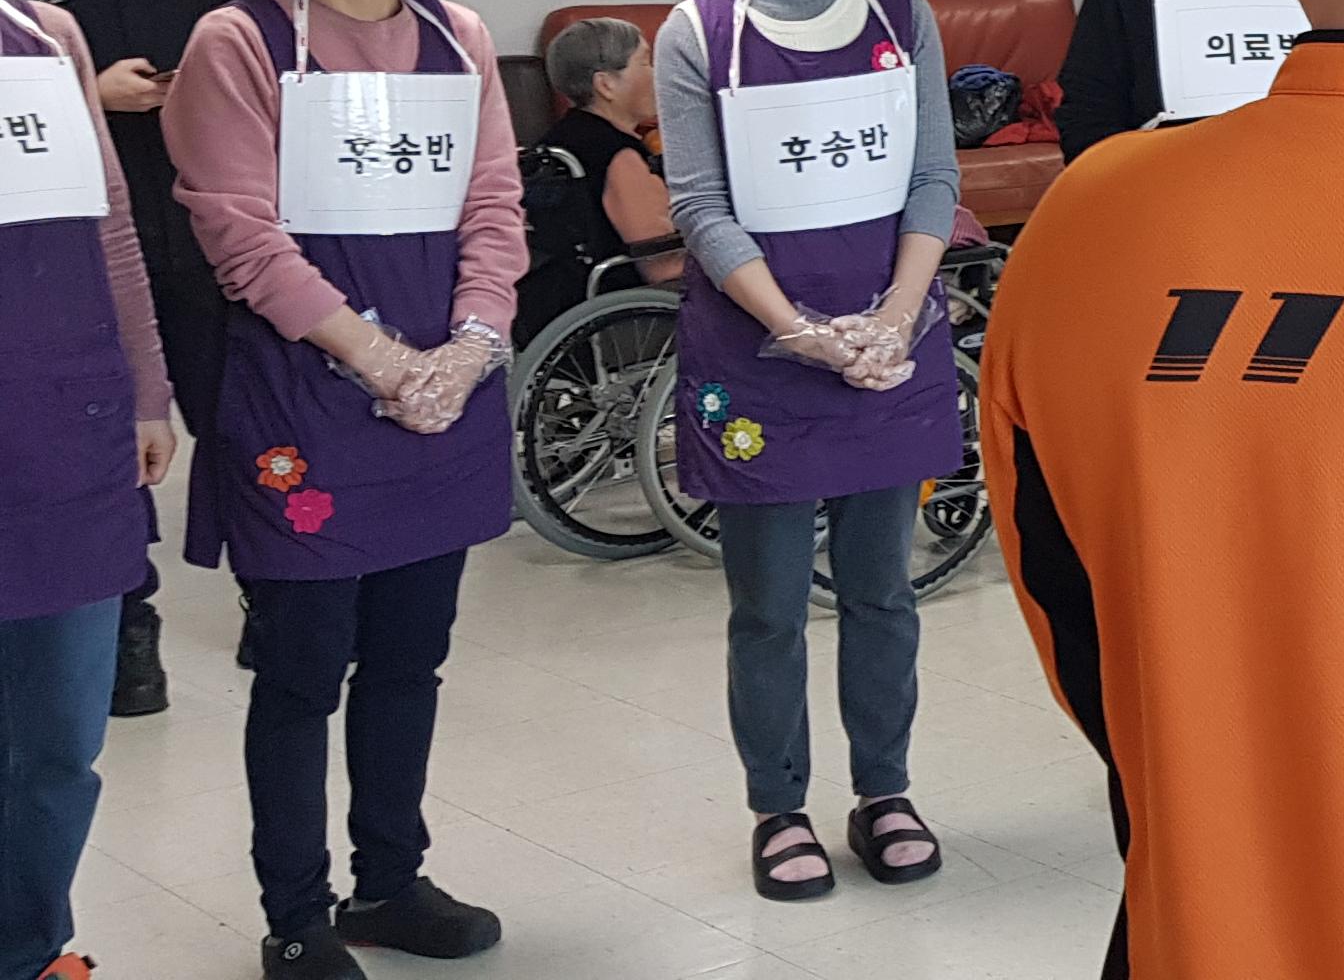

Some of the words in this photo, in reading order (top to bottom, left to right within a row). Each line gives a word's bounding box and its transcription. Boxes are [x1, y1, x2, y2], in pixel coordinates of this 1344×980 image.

[0, 113, 49, 154] 반
[338, 132, 455, 175] 후송반
[778, 123, 889, 173] 후송반
